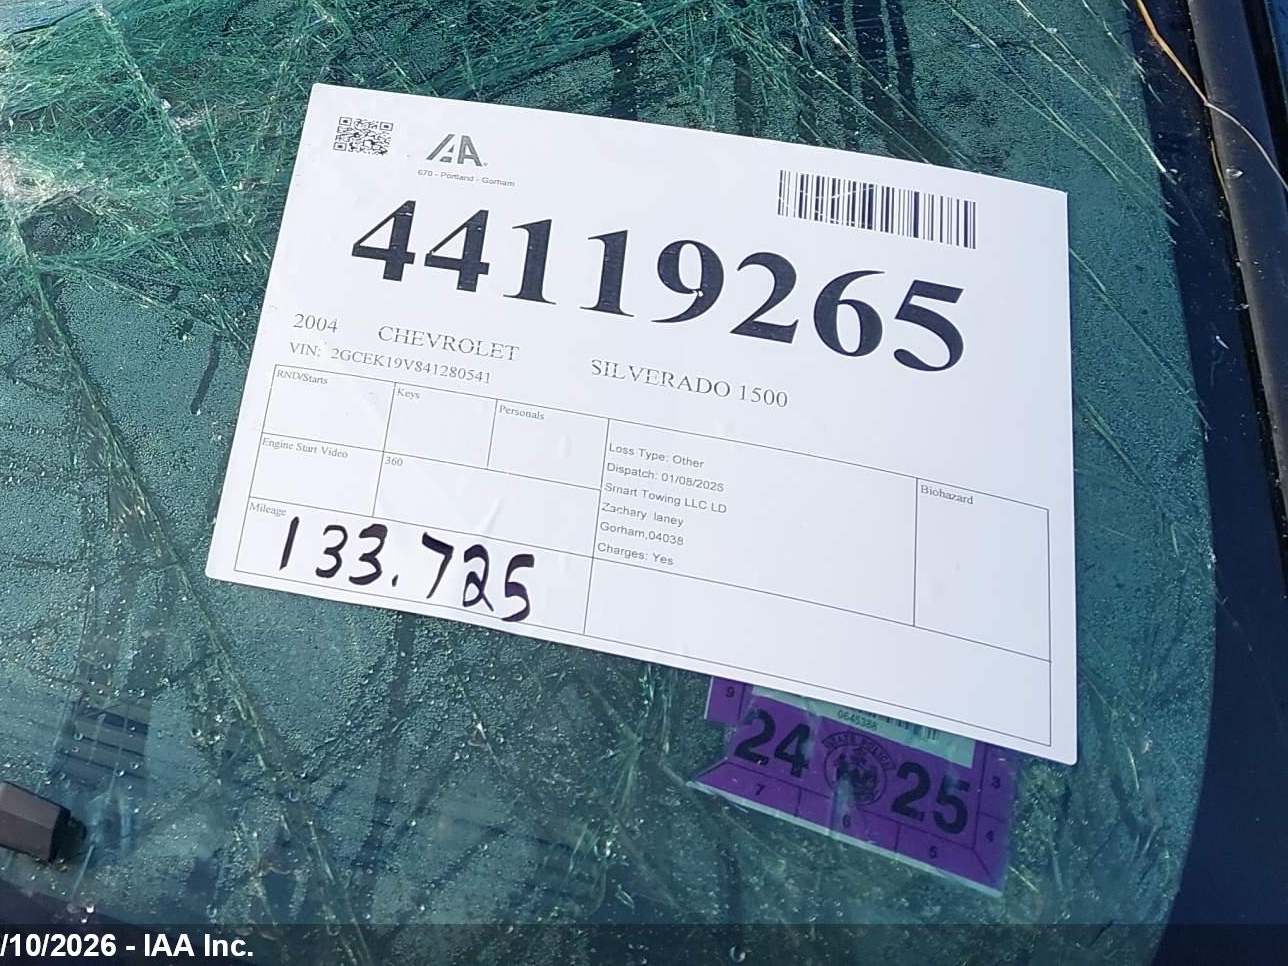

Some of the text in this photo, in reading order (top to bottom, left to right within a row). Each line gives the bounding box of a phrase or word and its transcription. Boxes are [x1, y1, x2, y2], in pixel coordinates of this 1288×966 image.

[440, 171, 474, 182] Portland
[481, 176, 515, 187] Gorham
[351, 200, 965, 372] 44119265
[289, 341, 491, 384] VIN: 2GCEK19V841280541
[293, 313, 789, 408] 2004 CHEVROLET SILVERADO 1500
[276, 369, 328, 385] RND/Starts
[396, 387, 421, 401] Keys
[499, 404, 545, 421] Personals
[262, 436, 348, 459] Engine Start Video
[609, 443, 704, 468] Loss Type: Other
[385, 456, 403, 467] 360
[606, 462, 658, 480] Dispatch:
[604, 482, 727, 514] Smart Towing LLC LD
[920, 484, 974, 505] Biohazard
[249, 501, 287, 518] Mileage
[601, 502, 647, 520] Zachary
[597, 542, 674, 566] Charges: Yes
[726, 686, 735, 698] 9
[734, 708, 810, 779] 24
[890, 761, 970, 835] 25
[842, 814, 851, 829] 6
[929, 846, 938, 859] 5
